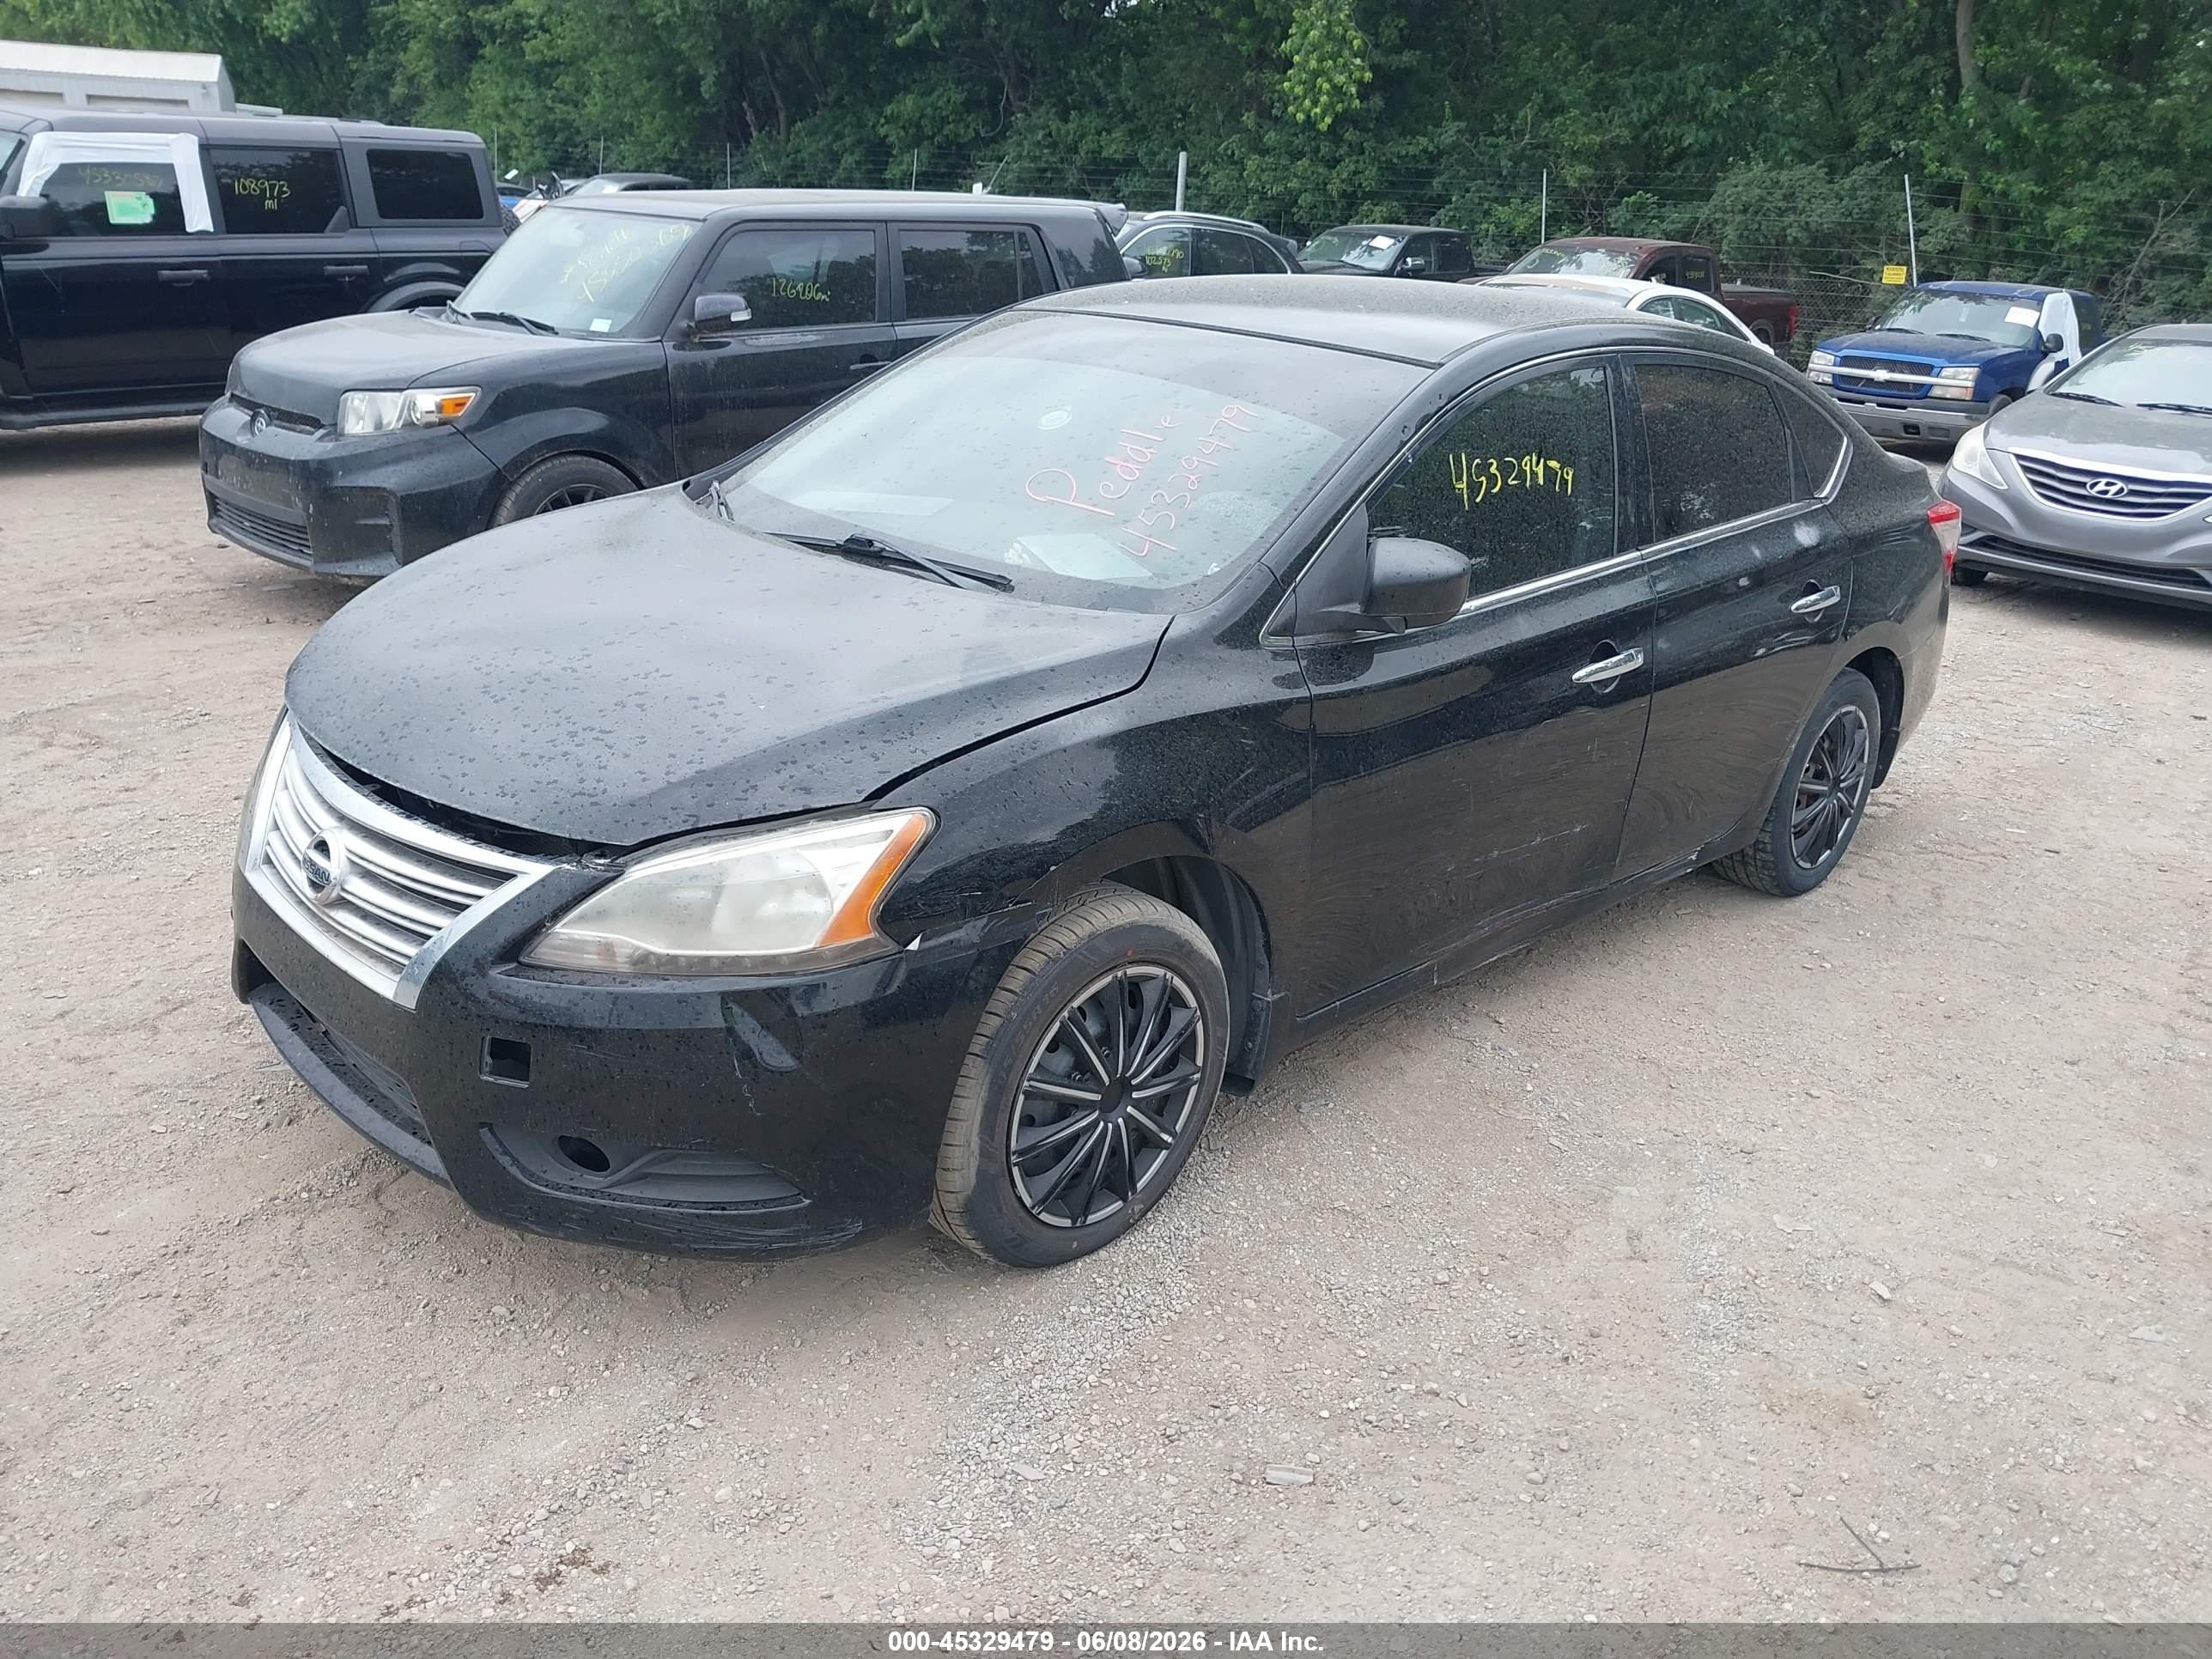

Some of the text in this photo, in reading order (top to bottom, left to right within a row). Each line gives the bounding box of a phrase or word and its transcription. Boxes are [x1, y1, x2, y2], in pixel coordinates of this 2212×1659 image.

[234, 178, 290, 198] 108973
[1118, 404, 1259, 556] 45329479
[1449, 452, 1574, 511] 45329479
